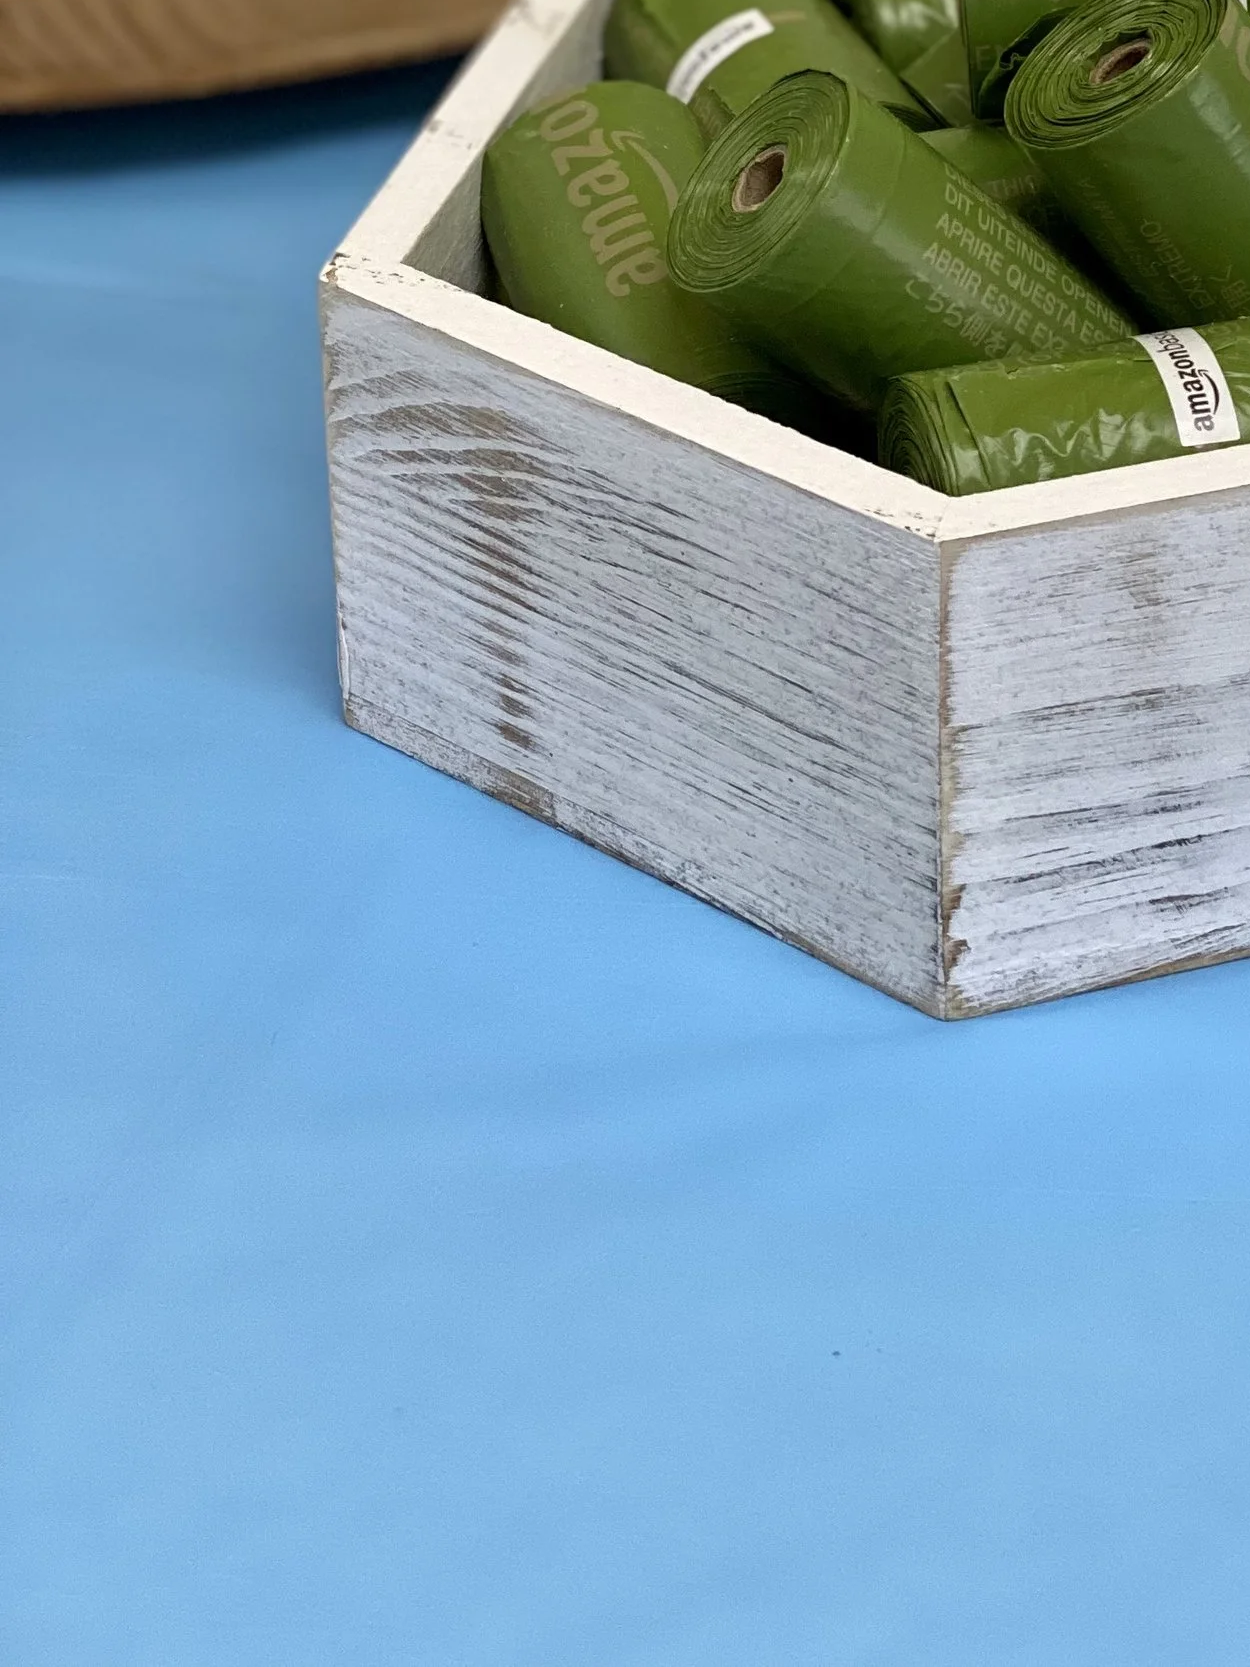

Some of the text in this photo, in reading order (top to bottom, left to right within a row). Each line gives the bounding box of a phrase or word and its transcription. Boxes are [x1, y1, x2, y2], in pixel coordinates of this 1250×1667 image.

[936, 212, 1004, 276] APRIRE
[1006, 264, 1077, 334] QUESTA
[944, 183, 974, 216] DIT
[977, 207, 1058, 284] UITEINDE
[922, 241, 982, 298] ABRIR
[981, 283, 1033, 336] ESTE
